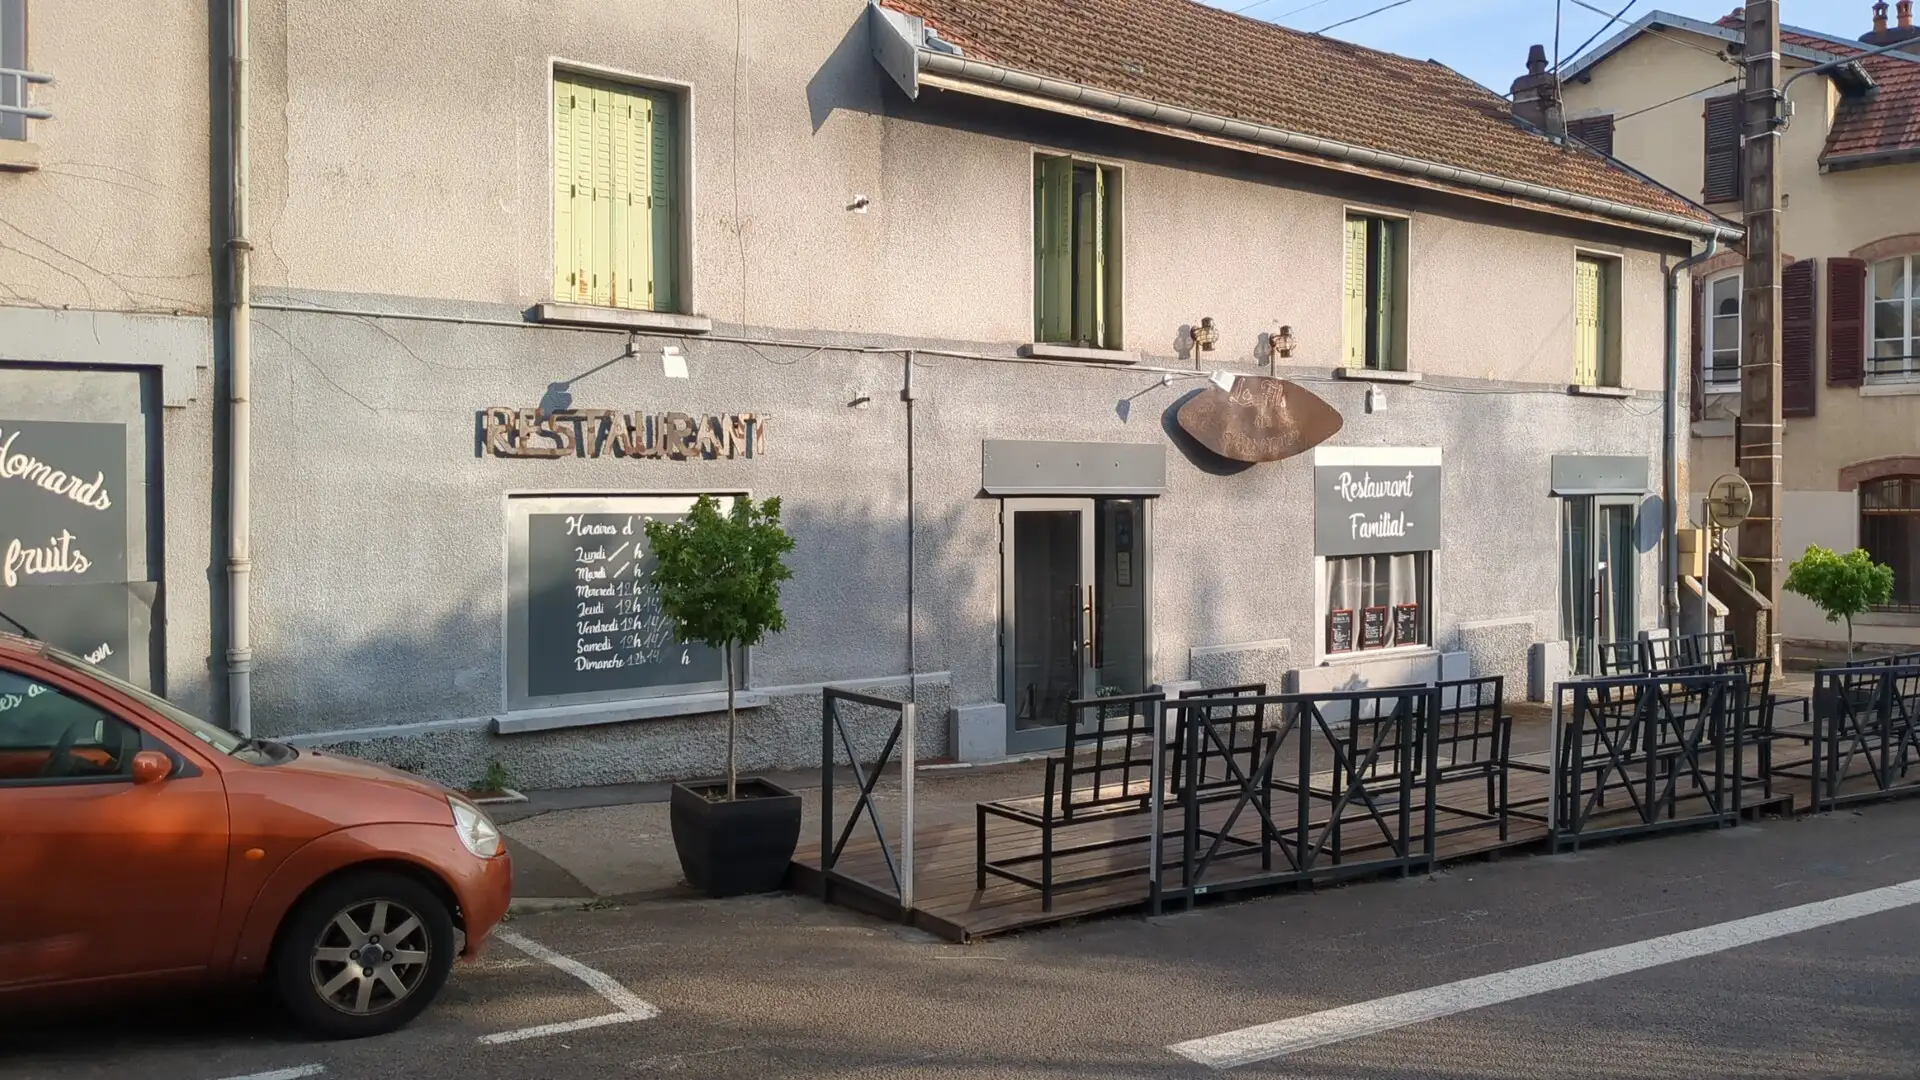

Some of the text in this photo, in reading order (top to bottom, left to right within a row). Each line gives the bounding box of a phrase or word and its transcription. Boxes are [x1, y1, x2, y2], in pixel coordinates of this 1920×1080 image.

[486, 406, 768, 456] RESTAURANT
[565, 513, 617, 536] Horaires
[4, 528, 93, 587] fruits
[575, 545, 606, 563] Lundi
[575, 566, 606, 582] Mardi
[575, 582, 615, 598] Mercredi
[577, 601, 605, 617] Jeudi
[576, 618, 619, 635] Vendredi
[576, 636, 613, 654] Samedi
[574, 653, 625, 671] Dimanche
